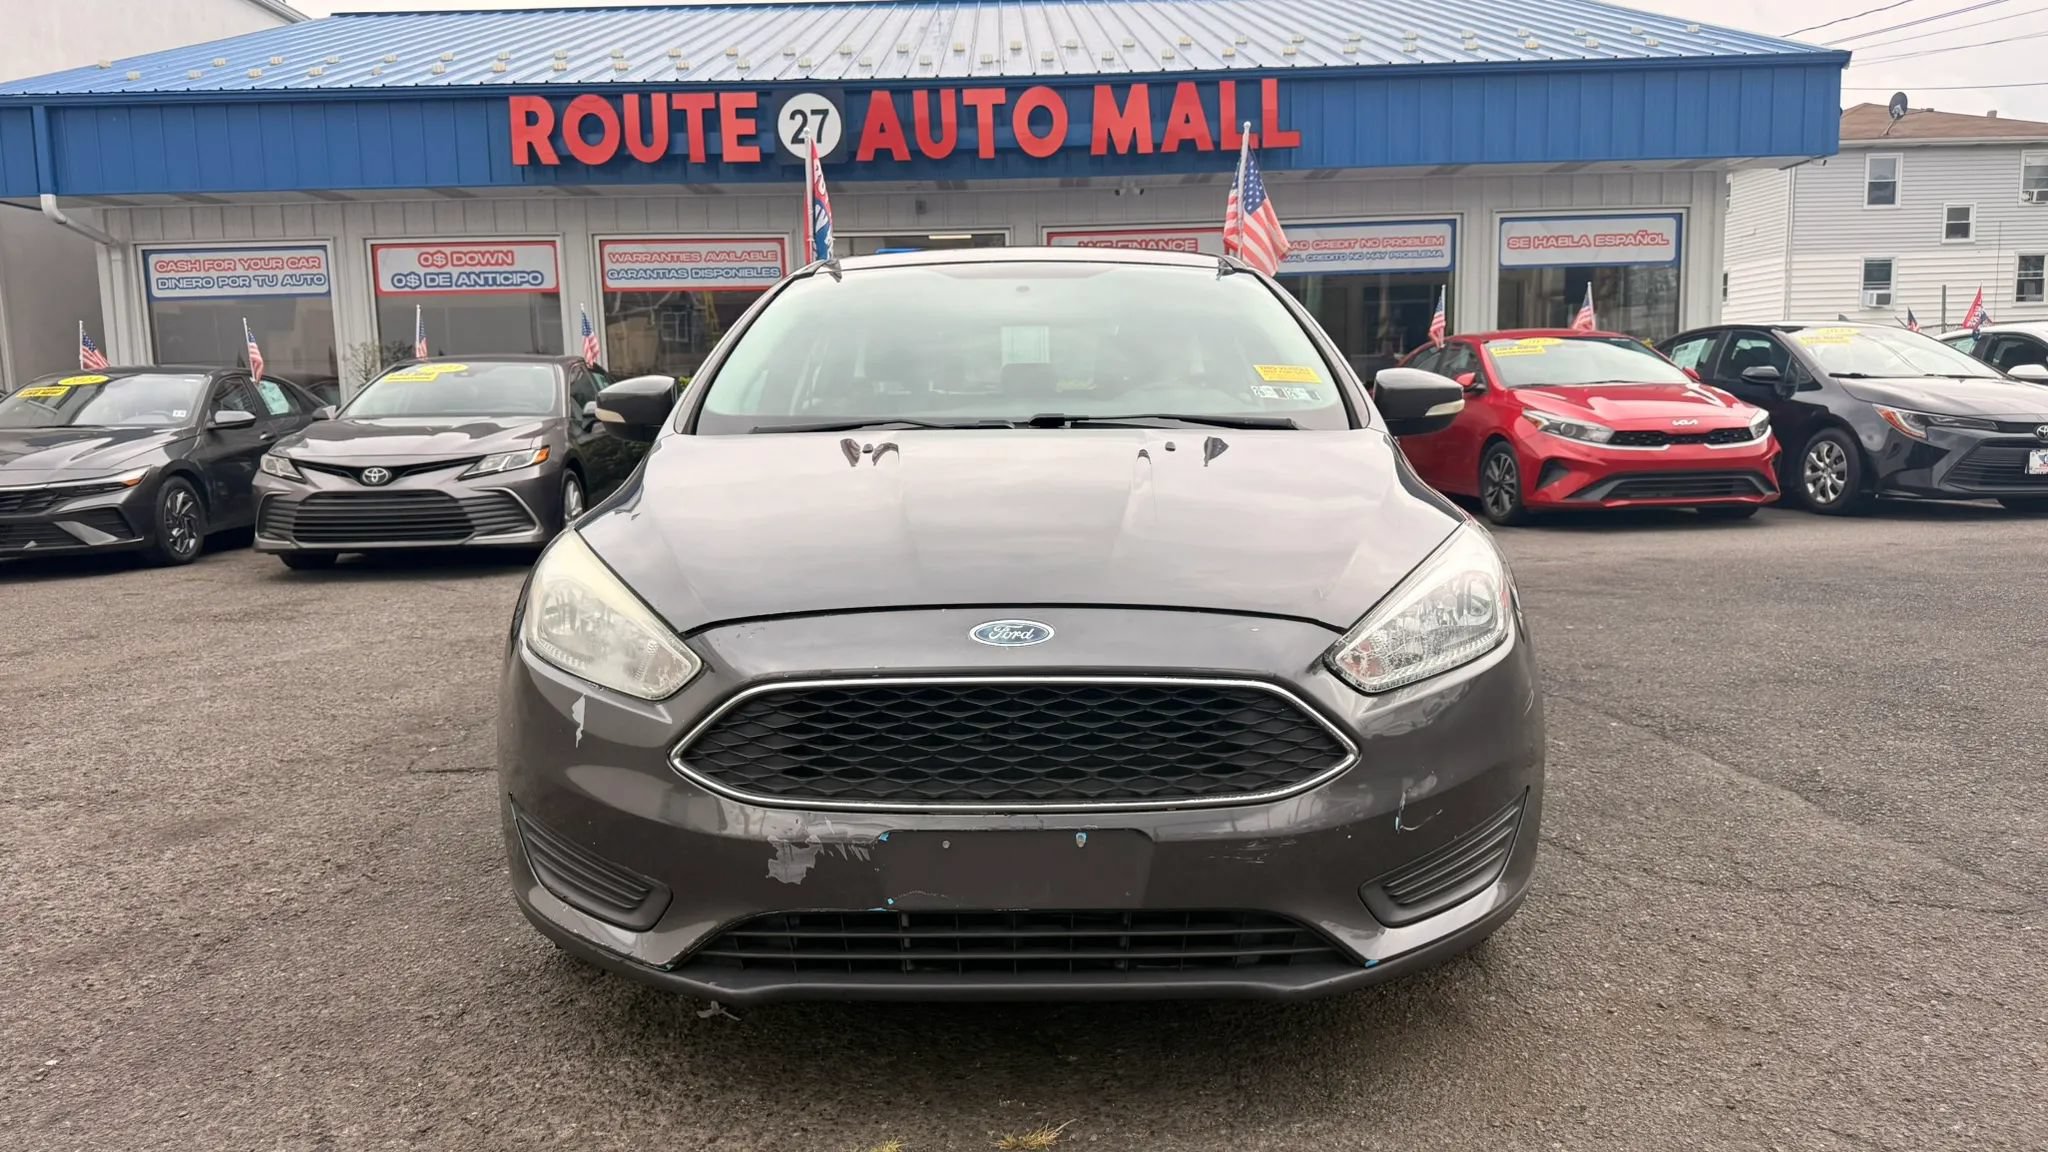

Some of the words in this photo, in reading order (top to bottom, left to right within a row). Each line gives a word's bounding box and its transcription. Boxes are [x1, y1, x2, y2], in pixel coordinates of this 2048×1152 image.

[509, 92, 761, 166] ROUTE
[789, 108, 830, 145] 27
[856, 85, 1068, 162] AUTO
[1090, 78, 1300, 156] MALL
[1312, 238, 1358, 251] CREDIT
[1359, 237, 1380, 249] NO
[1381, 235, 1444, 249] PROBLEM
[1507, 236, 1531, 250] SE
[1532, 234, 1590, 249] HABLA
[1593, 230, 1670, 248] ESPAÑOL
[450, 250, 514, 267] DOWN
[608, 251, 702, 264] WARRANTIES
[704, 250, 777, 262] AVAILABLE
[1305, 252, 1347, 262] CREDITO
[1348, 252, 1365, 261] NO
[1365, 251, 1387, 260] HAY
[1388, 249, 1444, 260] PROBLEMA
[155, 260, 201, 273] CASH
[203, 259, 236, 272] FOR
[239, 258, 283, 271] YOUR
[286, 256, 321, 269] CAR
[157, 277, 214, 290] DINERO
[217, 276, 251, 289] POR
[253, 275, 278, 288] TU
[281, 273, 326, 287] AUTO
[424, 272, 453, 288] DE
[455, 270, 544, 288] ANTICIPO
[607, 267, 689, 280] GARANTIAS
[690, 267, 781, 279] DISPONIBLES
[988, 625, 1035, 640] Ford
